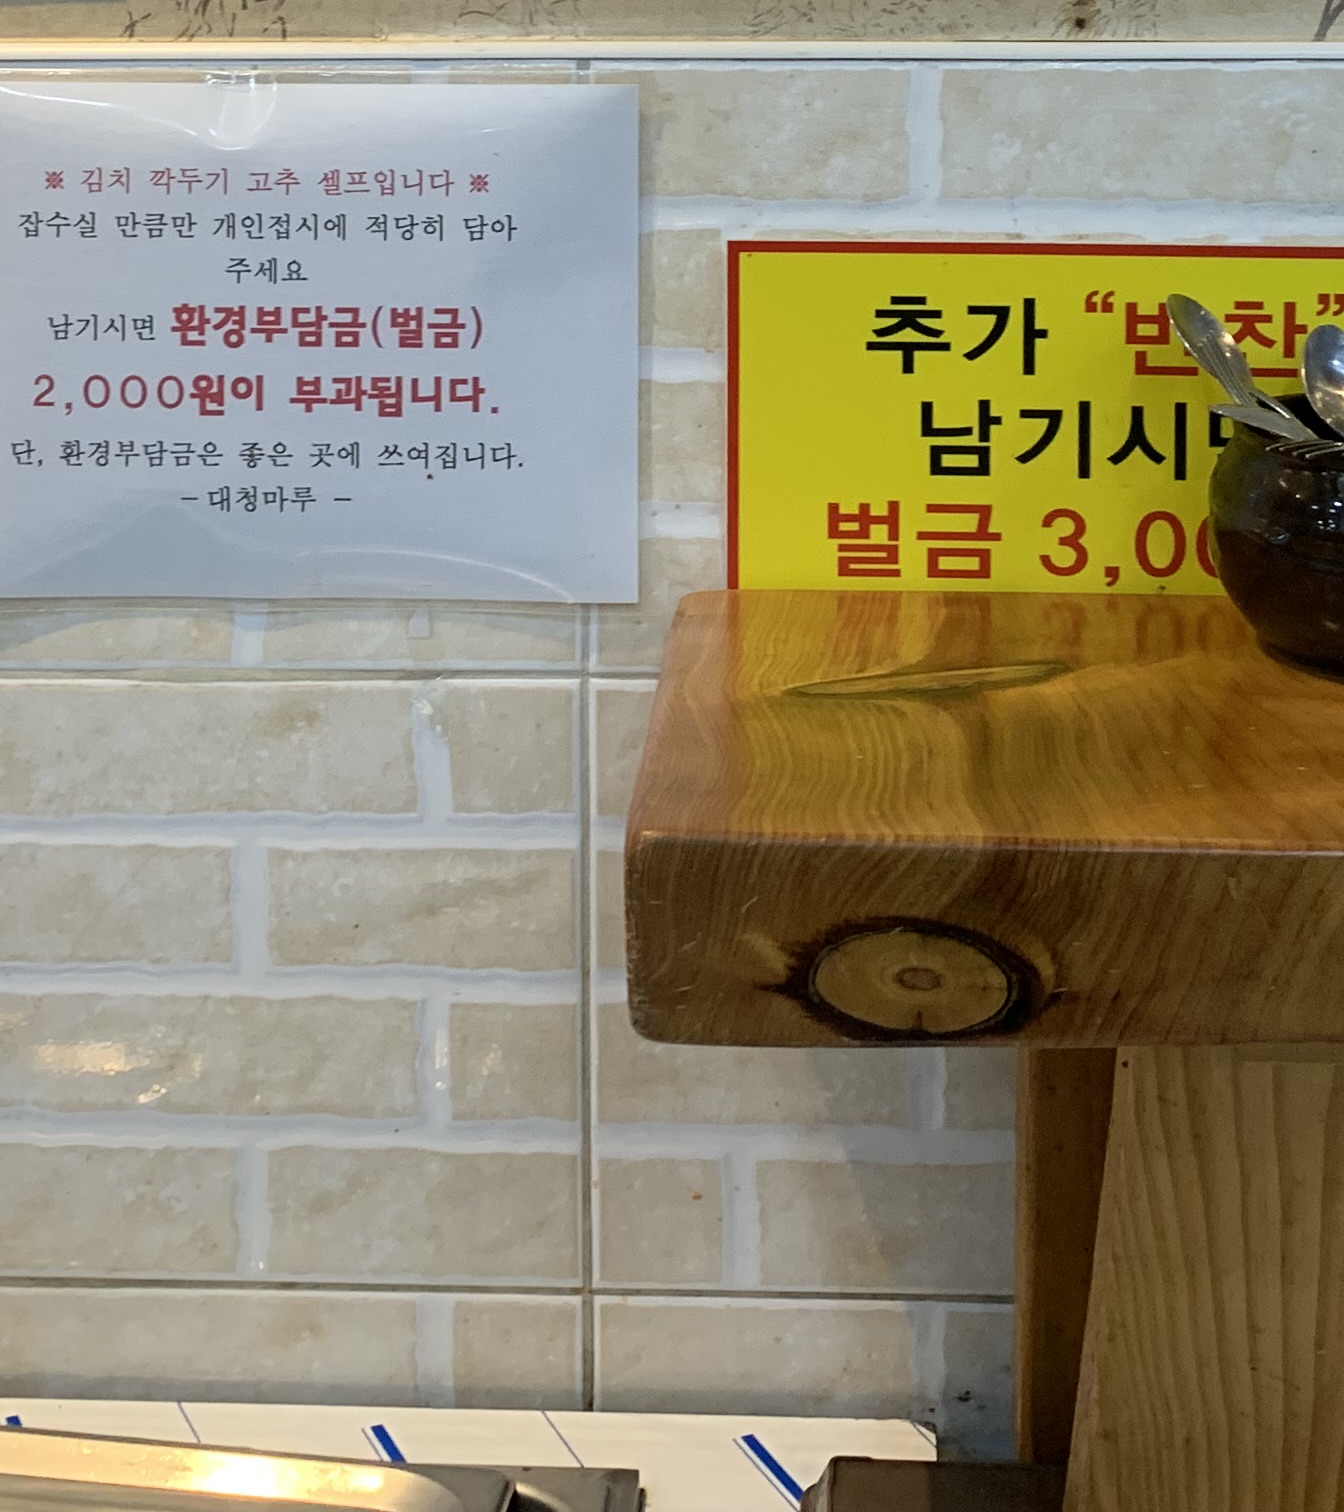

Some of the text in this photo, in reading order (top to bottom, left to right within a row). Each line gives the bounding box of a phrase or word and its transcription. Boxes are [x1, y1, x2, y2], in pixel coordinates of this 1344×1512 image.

[80, 167, 133, 195] 김치
[149, 166, 229, 196] 깍두기
[247, 167, 301, 195] 고추
[317, 168, 455, 198] 셀프입니다
[17, 211, 517, 243] 잡수실 만큼만 개인접시에 적당히 담아
[225, 256, 308, 285] 주세요
[47, 303, 484, 350] 남기시면 환경부담금(벌금)
[866, 296, 1048, 374] 추가
[33, 373, 500, 419] 2,000원이 부과됩니다.
[10, 439, 524, 471] 단, 환경부담금은 좋은 곳에 쓰여집니다.
[920, 399, 1233, 479] 남기시
[208, 485, 316, 514] 대청마루
[827, 501, 1001, 578] 벌금
